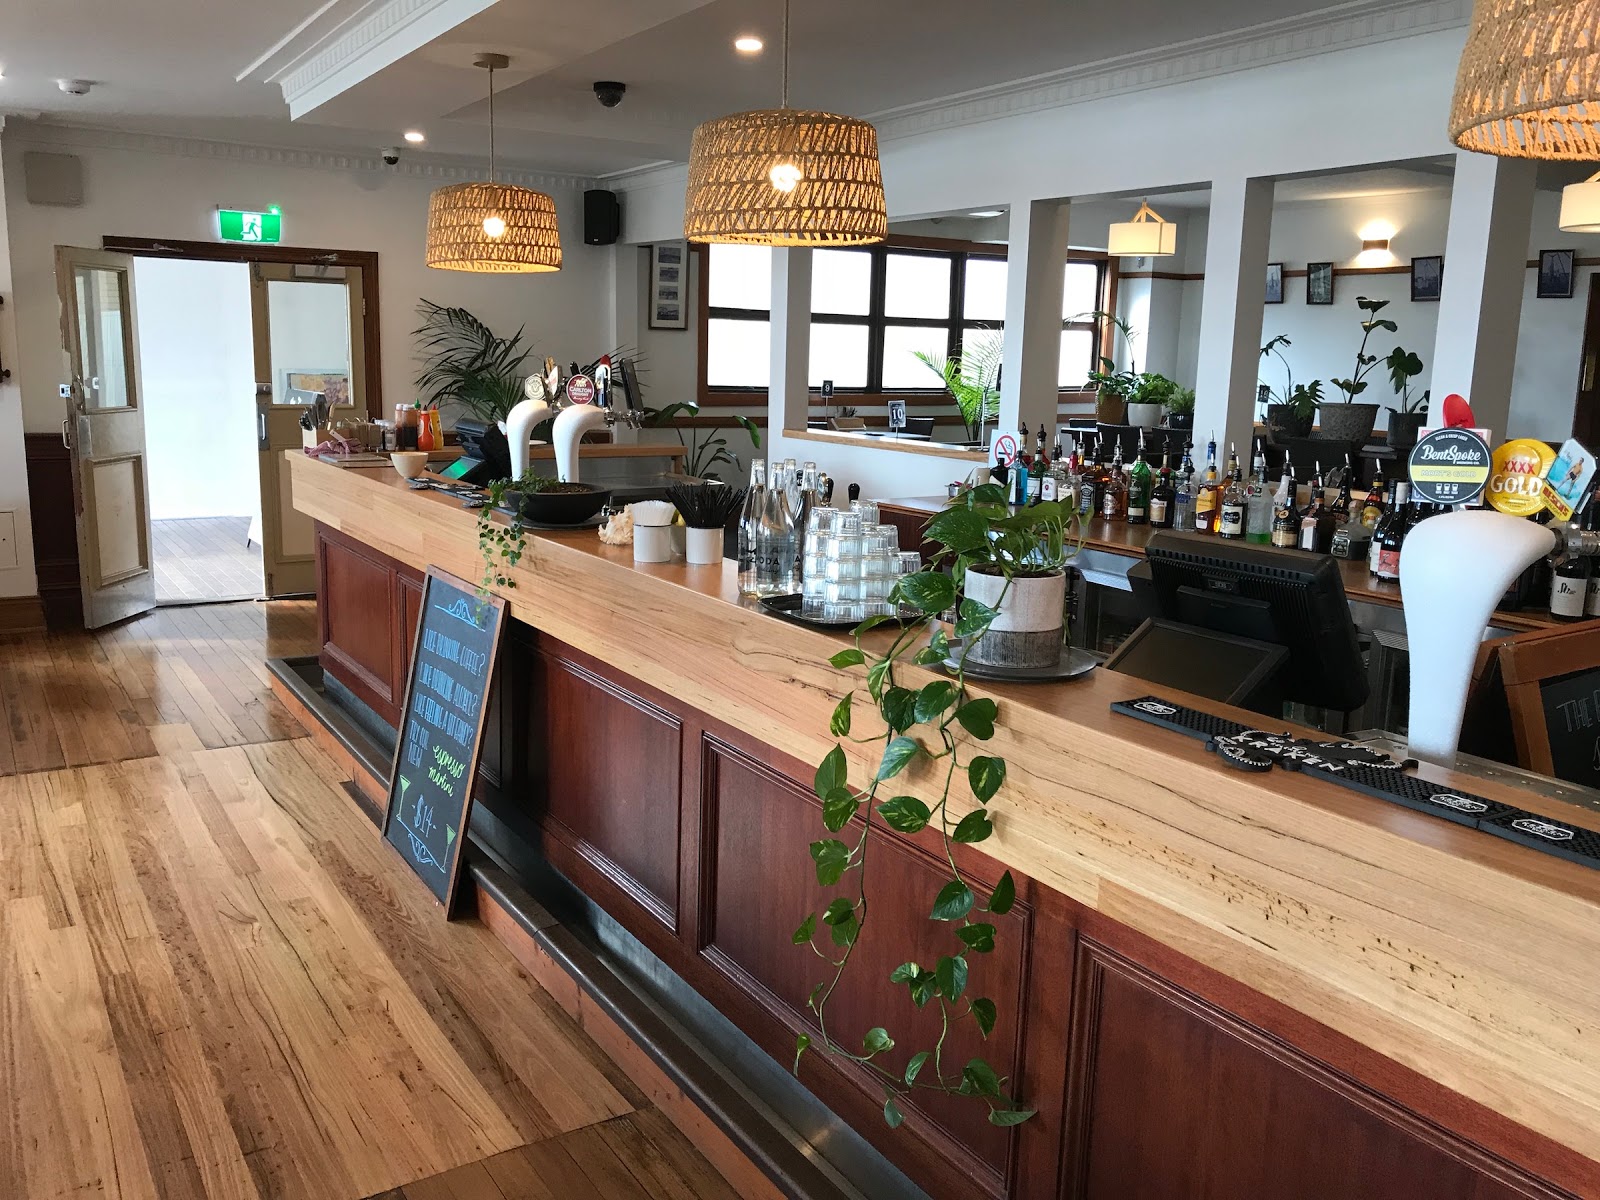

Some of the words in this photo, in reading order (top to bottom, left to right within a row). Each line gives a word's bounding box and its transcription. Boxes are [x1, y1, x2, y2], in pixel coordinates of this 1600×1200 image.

[892, 409, 903, 420] 10
[1420, 444, 1481, 465] BentSpoke
[1503, 460, 1536, 475] XXXX
[1490, 474, 1543, 497] GOLD
[757, 555, 780, 566] ODA
[459, 645, 486, 676] COFFEE?
[1556, 697, 1594, 733] THE
[407, 741, 423, 768] NEW
[432, 745, 466, 779] espresso
[1231, 735, 1345, 772] KRAKEN
[428, 766, 456, 798] martini
